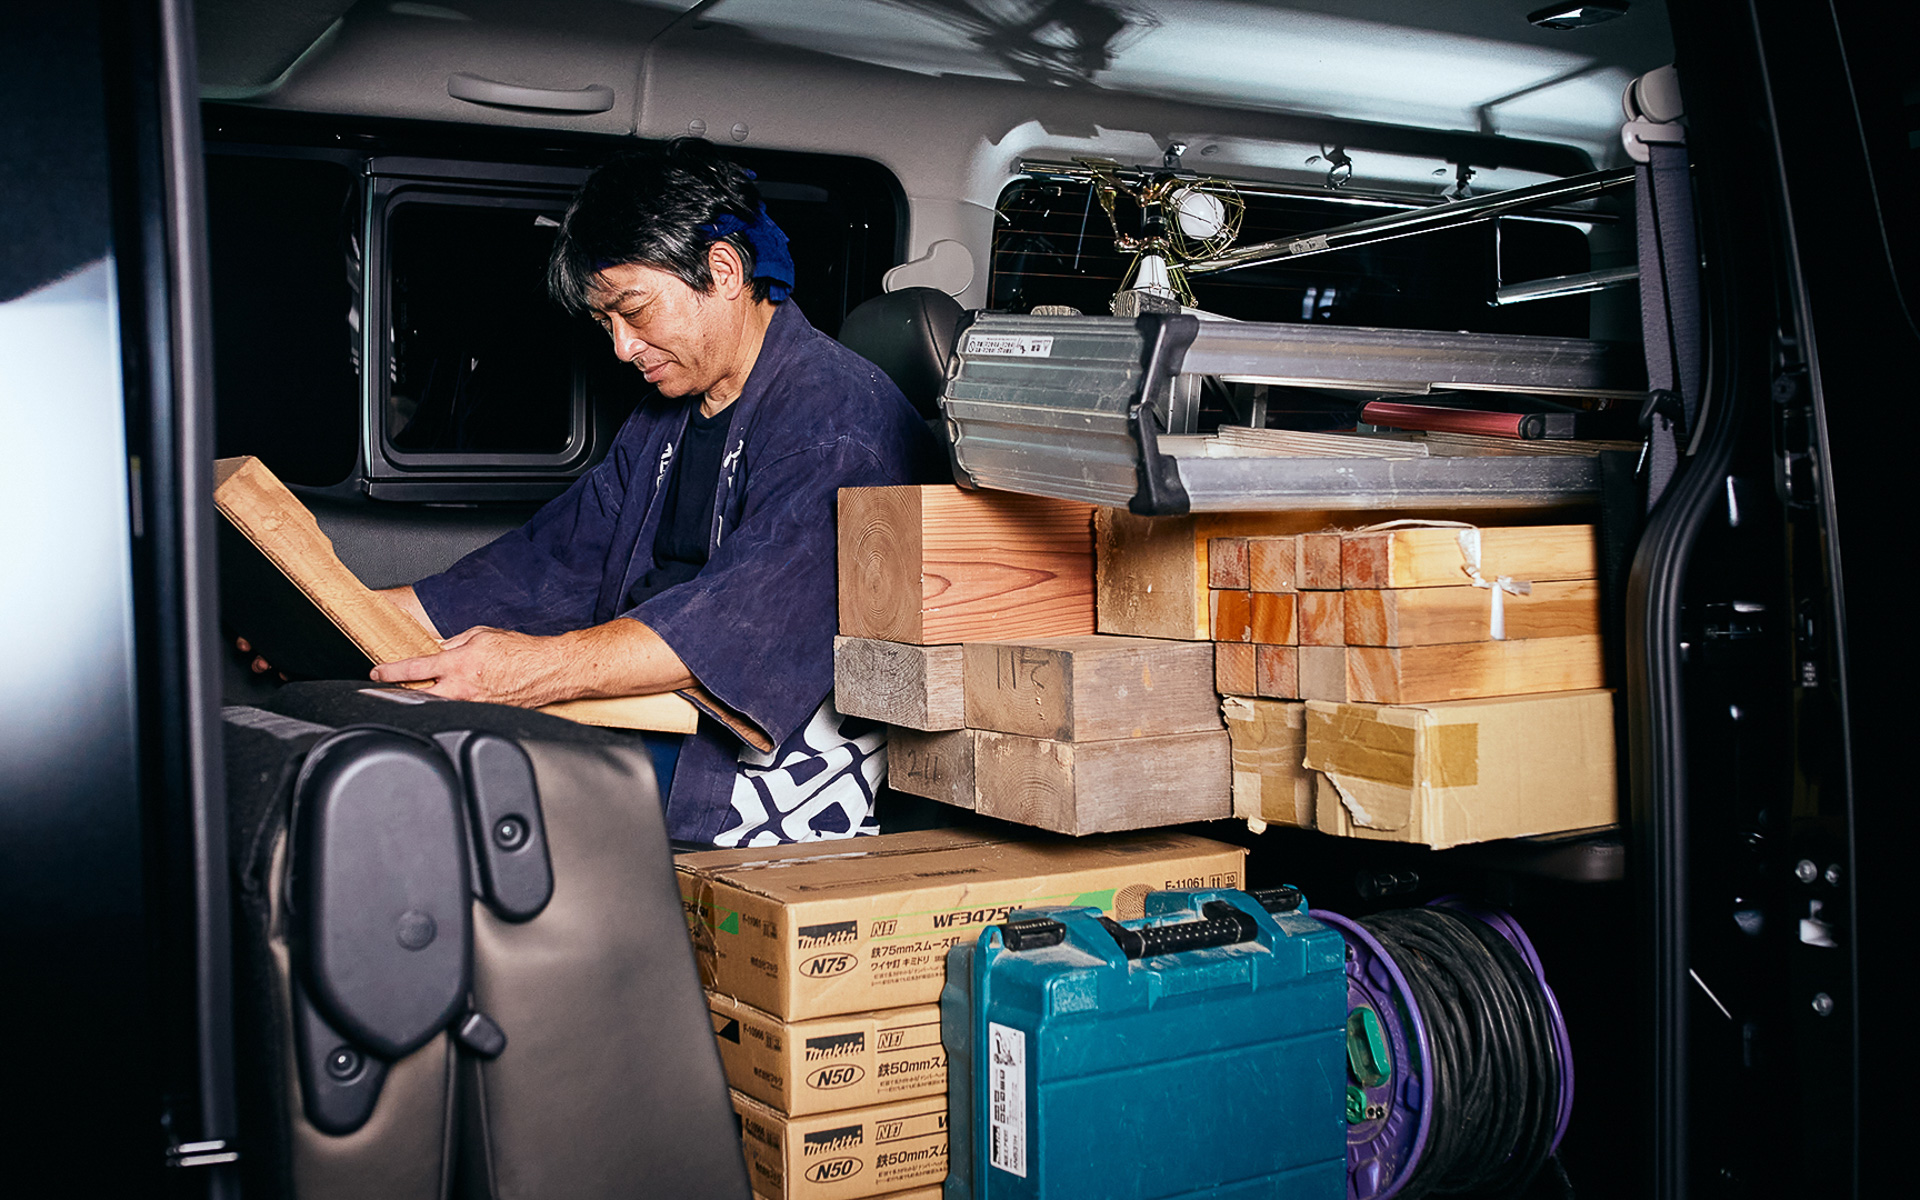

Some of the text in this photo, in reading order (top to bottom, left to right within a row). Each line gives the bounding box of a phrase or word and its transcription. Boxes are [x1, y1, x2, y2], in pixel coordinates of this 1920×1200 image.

[798, 921, 858, 950] makita
[810, 956, 849, 977] N75
[805, 1032, 865, 1062] makita
[816, 1067, 855, 1088] N50
[804, 1124, 863, 1156] makita
[815, 1159, 854, 1181] N50
